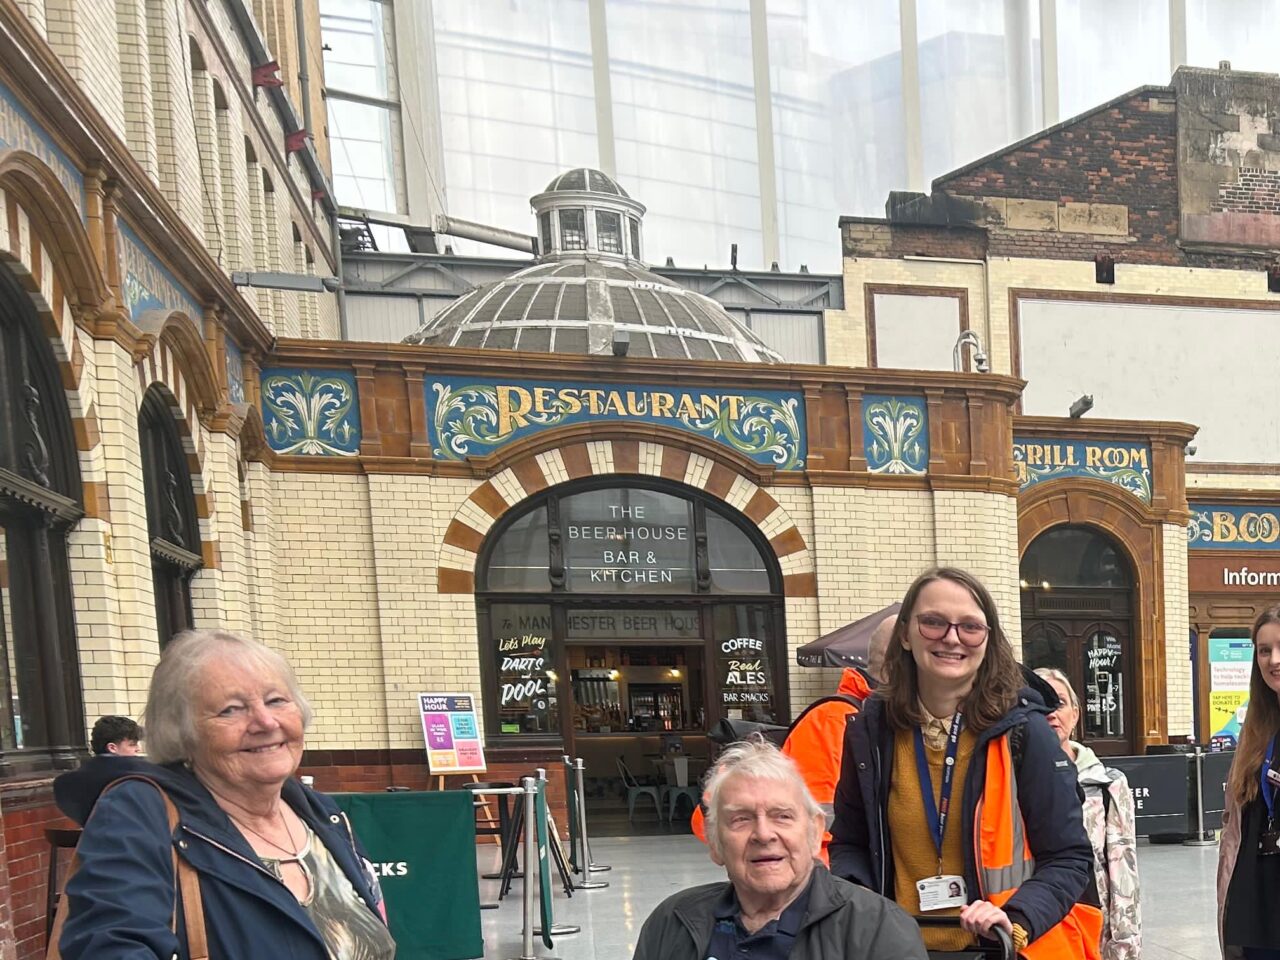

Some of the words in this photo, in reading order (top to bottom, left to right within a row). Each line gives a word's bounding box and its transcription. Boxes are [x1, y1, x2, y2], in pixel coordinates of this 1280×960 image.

[495, 384, 749, 437] RESTAURANT
[1086, 445, 1148, 469] ROOM
[609, 505, 646, 519] THE
[568, 526, 617, 540] BEER
[623, 527, 688, 540] HOUSE
[603, 551, 640, 564] BAR
[646, 551, 657, 564] &
[590, 569, 673, 583] KITCHEN
[519, 615, 616, 630] MANHESTER
[623, 616, 657, 630] BEER
[499, 636, 519, 651] Let's
[522, 633, 546, 651] Play
[721, 637, 764, 654] COFFEE
[1087, 648, 1113, 659] HAPPY
[501, 657, 544, 672] DARTS
[728, 659, 764, 672] Real
[725, 672, 766, 685] ALES
[501, 678, 547, 705] POOL
[723, 693, 739, 702] BAR
[741, 693, 769, 702] SNACKS
